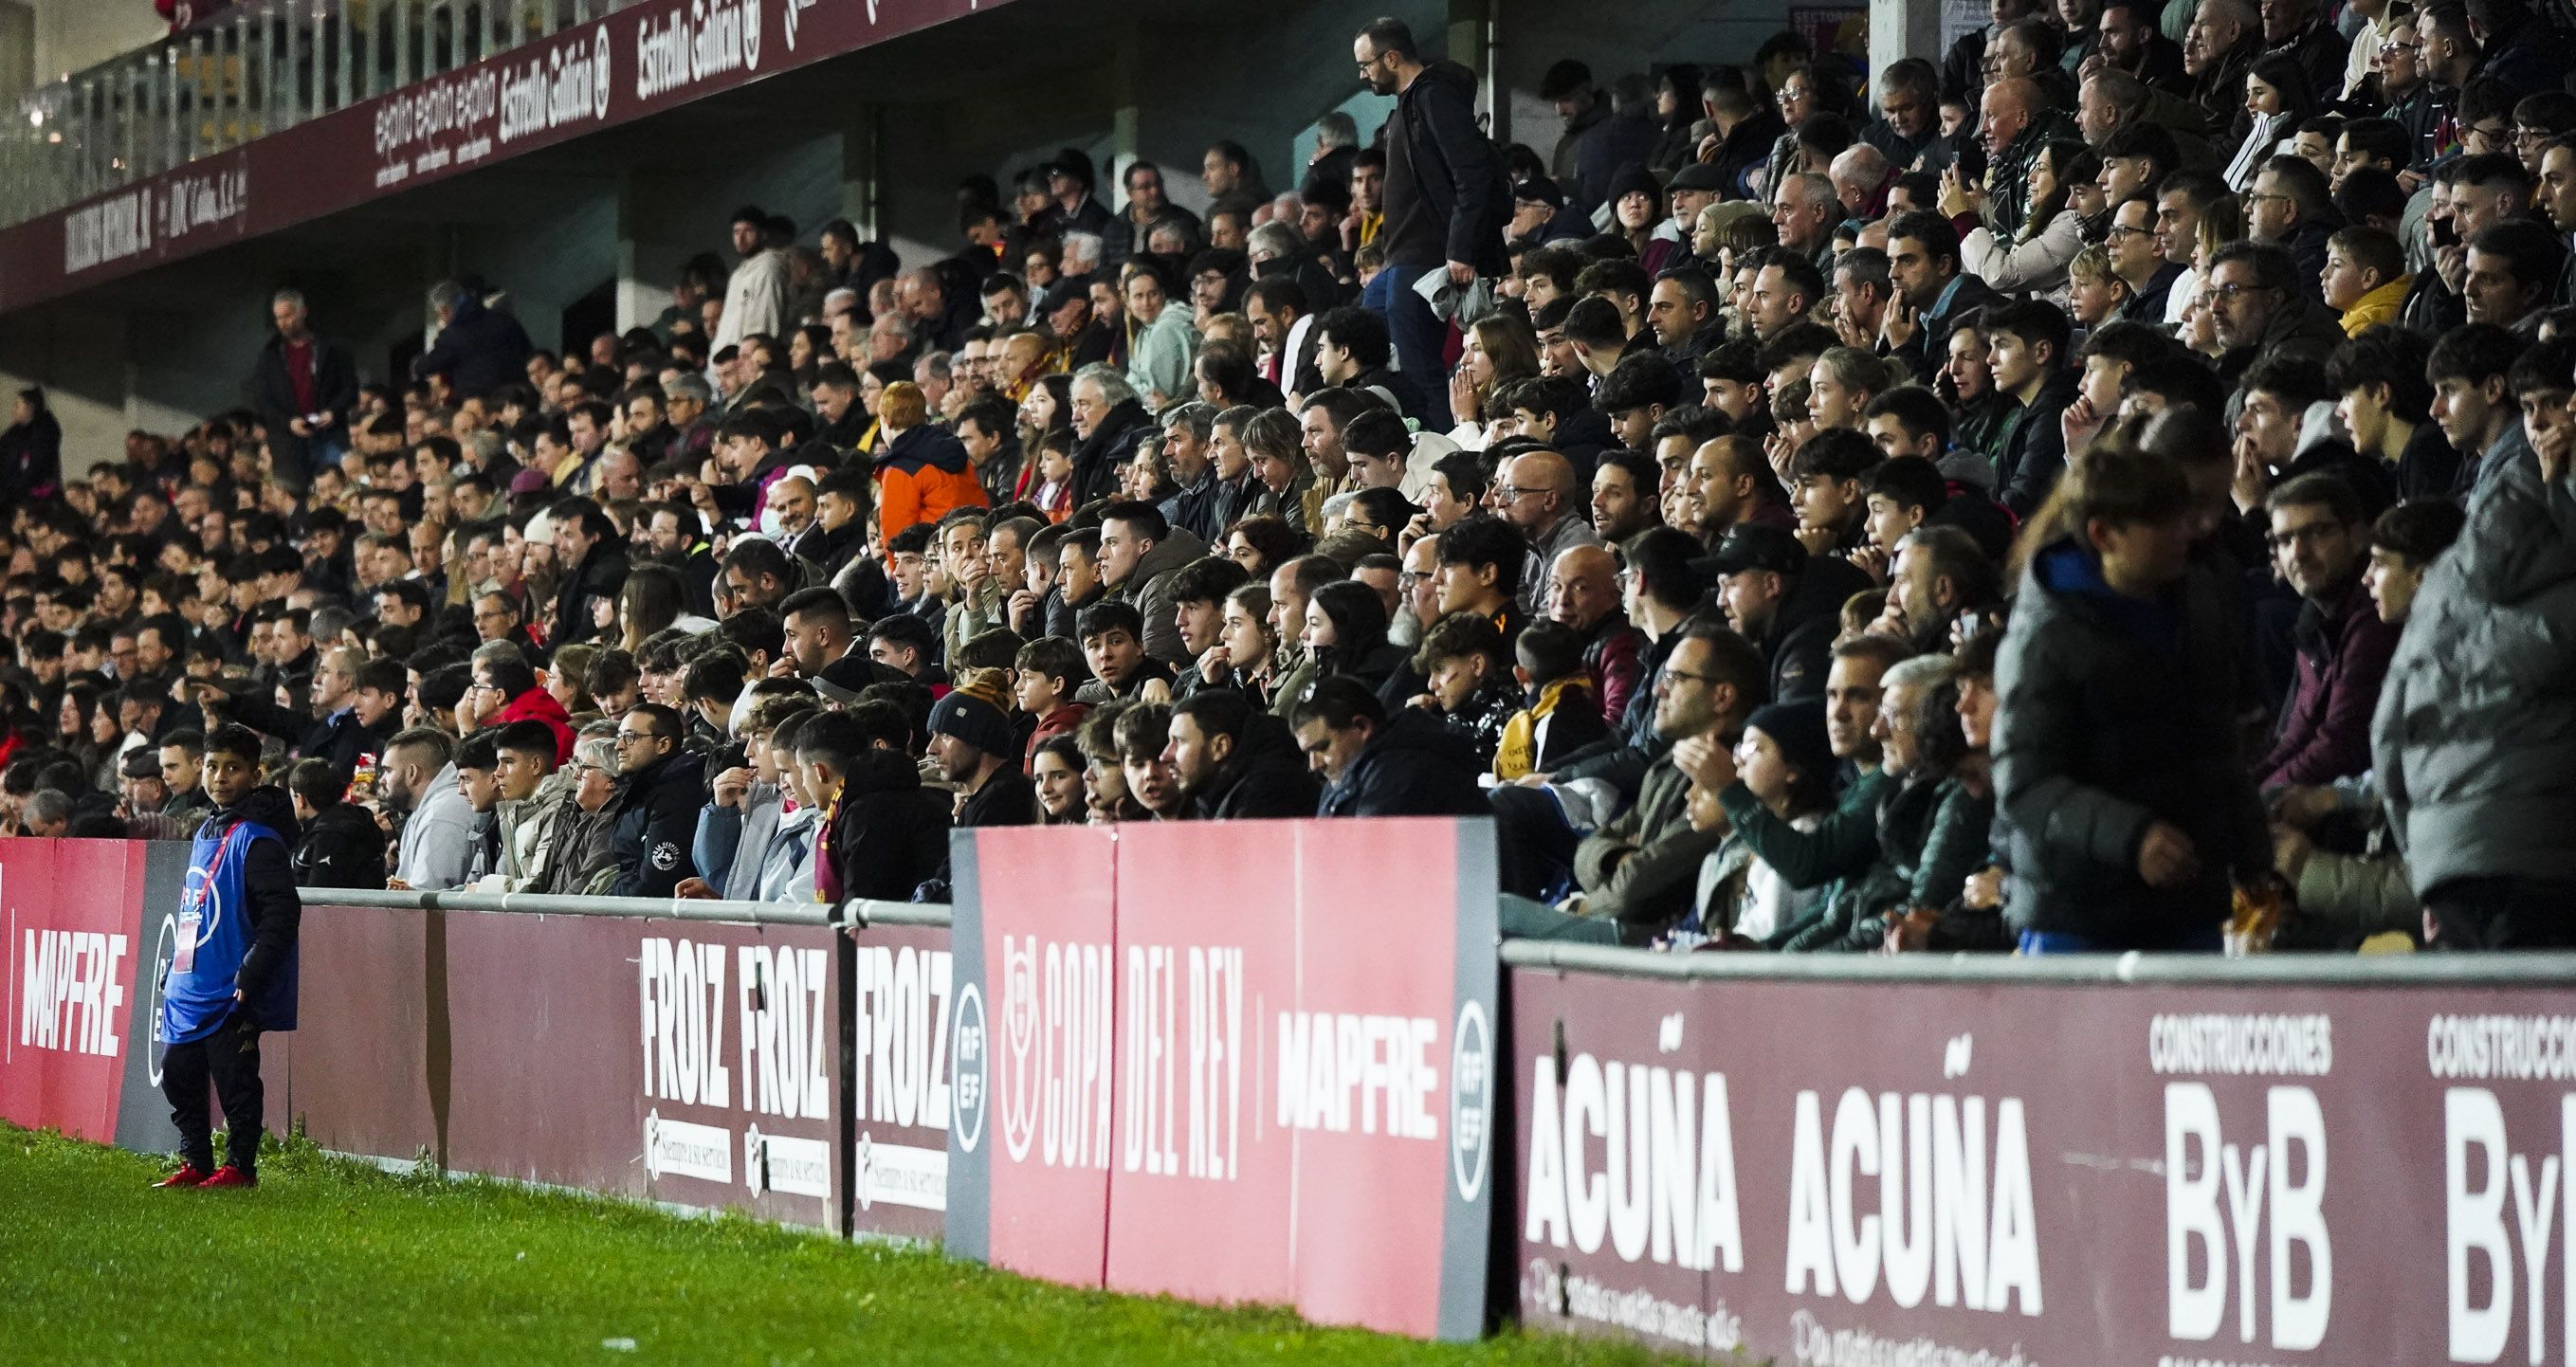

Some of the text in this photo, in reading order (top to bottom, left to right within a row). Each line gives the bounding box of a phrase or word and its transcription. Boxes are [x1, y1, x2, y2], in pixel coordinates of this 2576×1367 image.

[498, 39, 593, 143] Estrella Galicia
[637, 9, 690, 100] Estrella
[21, 928, 127, 1057] MAPFRE
[641, 938, 730, 1109] FROIZ
[738, 945, 831, 1121] FROIZ
[855, 945, 953, 1130] FROIZ
[1124, 944, 1179, 1176] DEL
[1188, 945, 1243, 1182] REY
[2149, 1013, 2333, 1076] CONSTRUCCIONES
[959, 1074, 980, 1109] EF
[1277, 1011, 1438, 1140] MAPFRE
[1526, 1012, 1745, 1272] ACUÑA
[1786, 1030, 2044, 1316] ACUÑA
